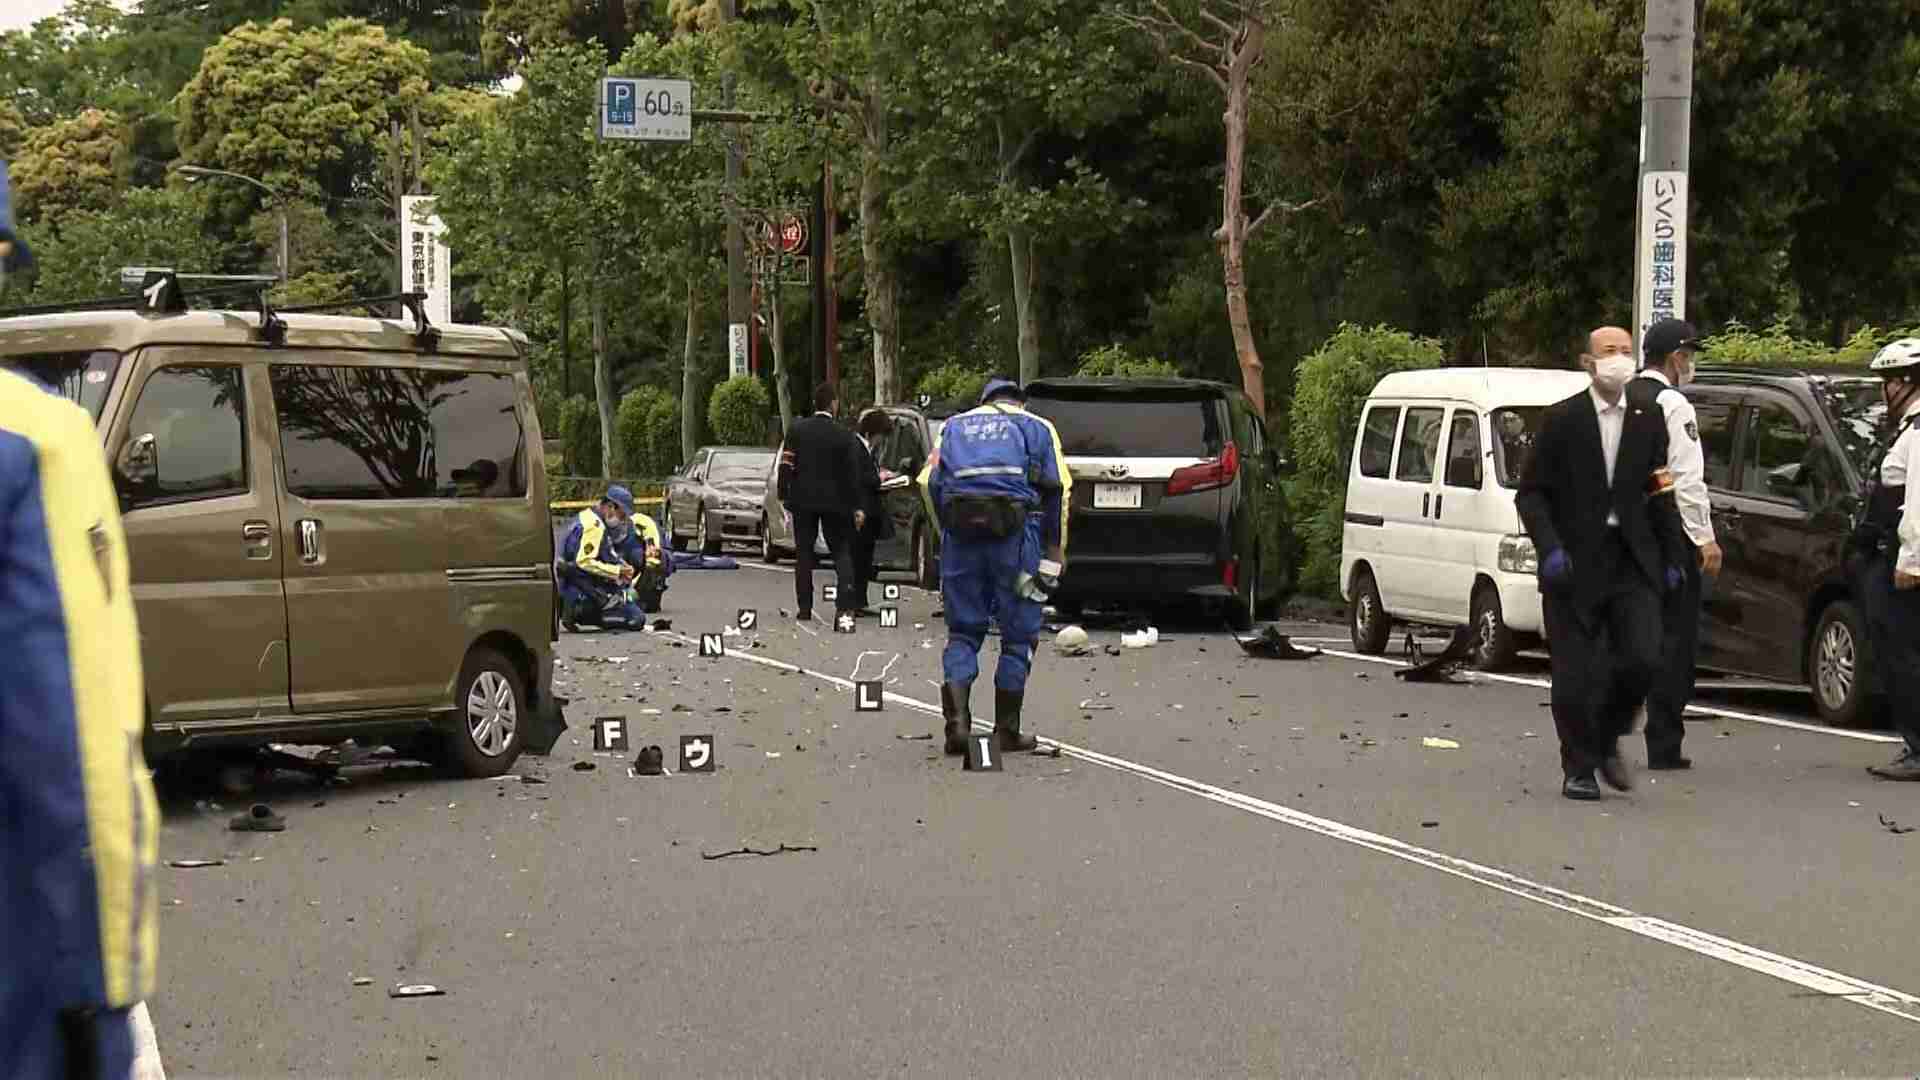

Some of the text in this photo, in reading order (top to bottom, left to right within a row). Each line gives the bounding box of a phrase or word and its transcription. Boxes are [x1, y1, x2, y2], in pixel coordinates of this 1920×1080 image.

[615, 85, 630, 111] P
[644, 90, 684, 117] 60分
[739, 611, 756, 629] ク
[838, 614, 854, 631] キ
[880, 608, 898, 627] M
[703, 635, 723, 655] N
[860, 684, 878, 708] L
[603, 721, 621, 748] F
[685, 738, 710, 768] ウ
